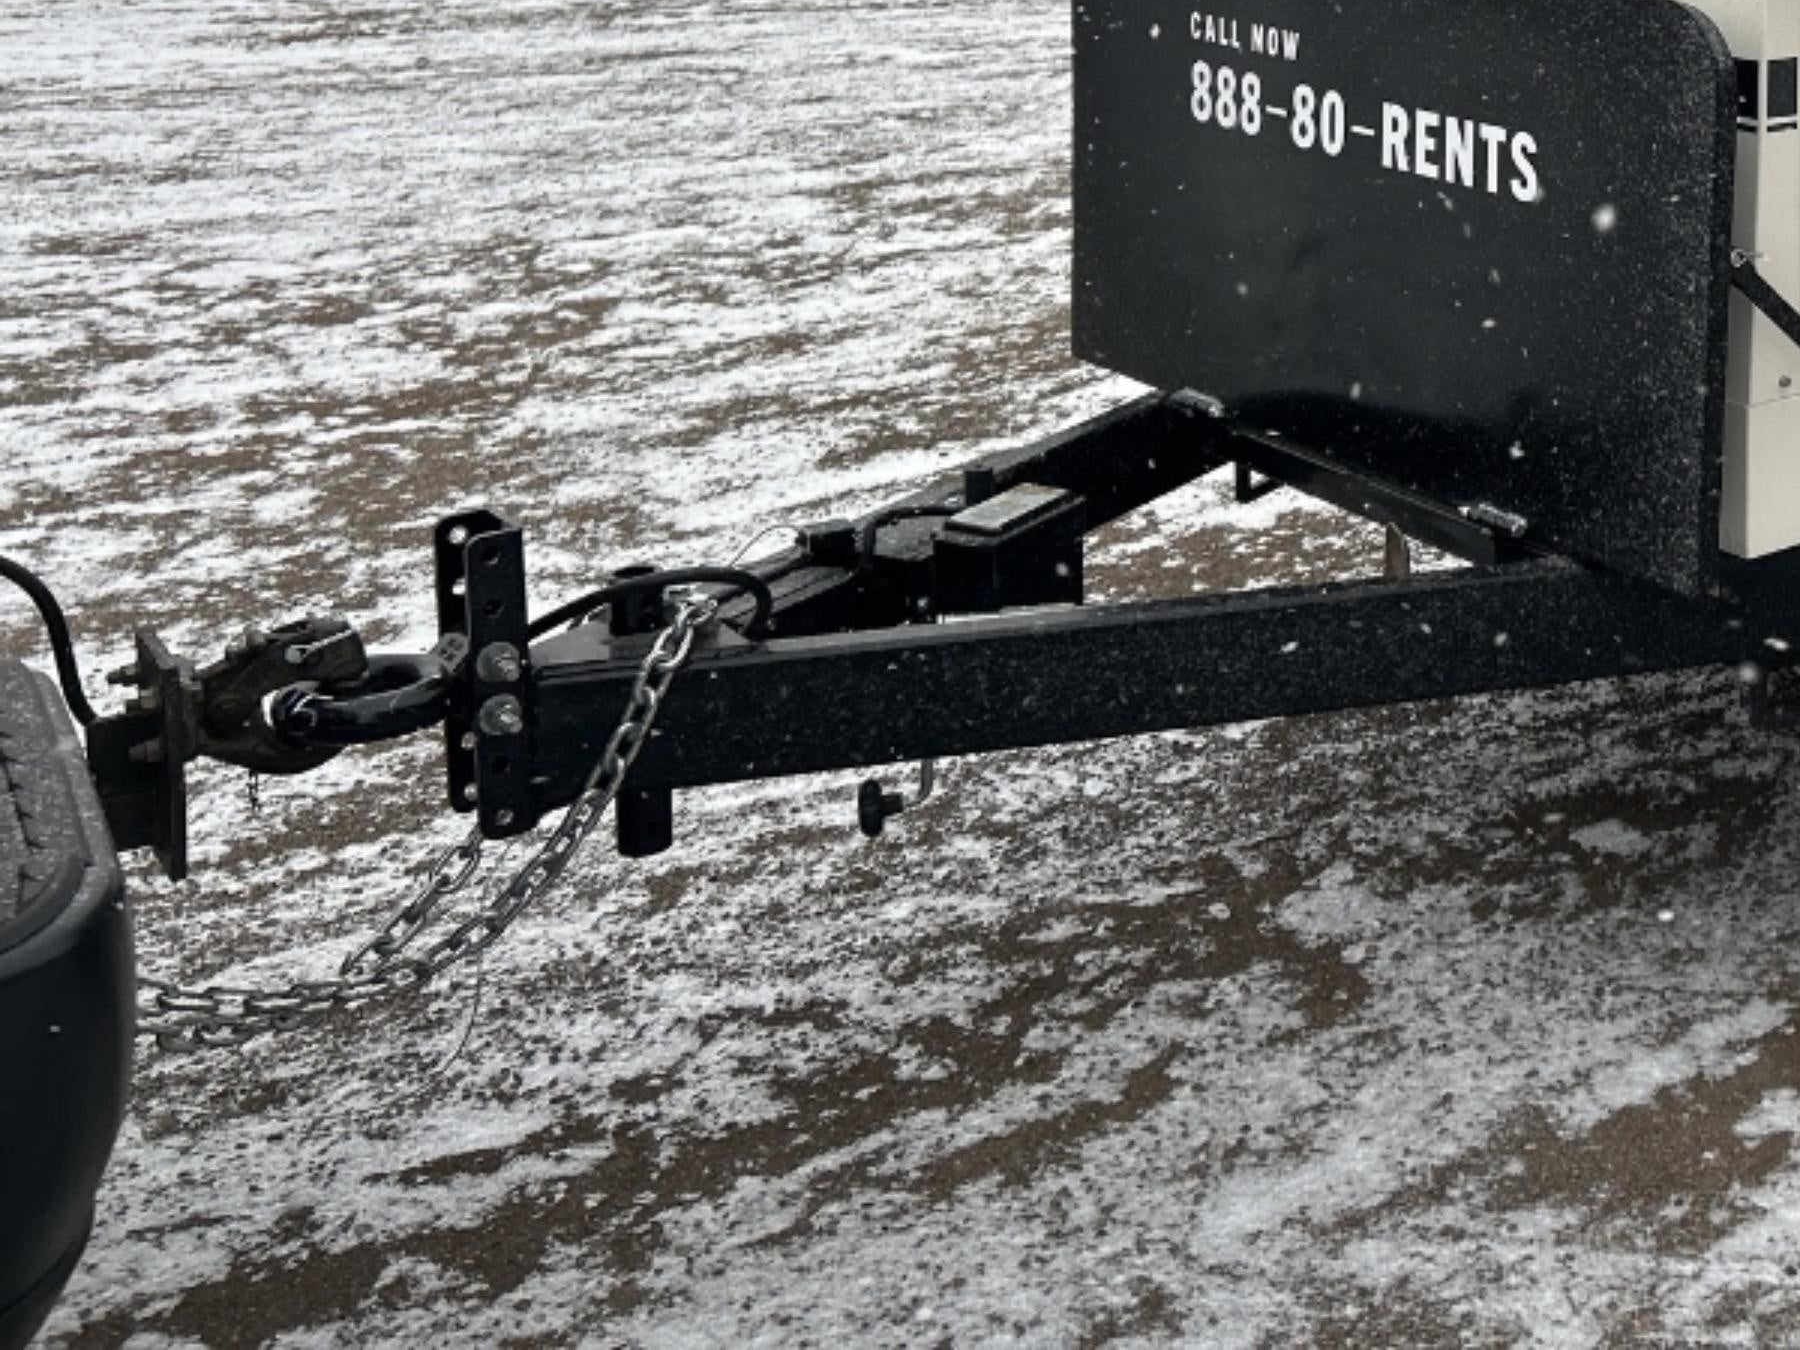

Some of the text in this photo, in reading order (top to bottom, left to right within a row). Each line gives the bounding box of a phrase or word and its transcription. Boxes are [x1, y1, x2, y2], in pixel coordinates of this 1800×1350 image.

[1190, 11, 1300, 61] CALL NOW
[1190, 59, 1538, 203] 888-80-RENTS
